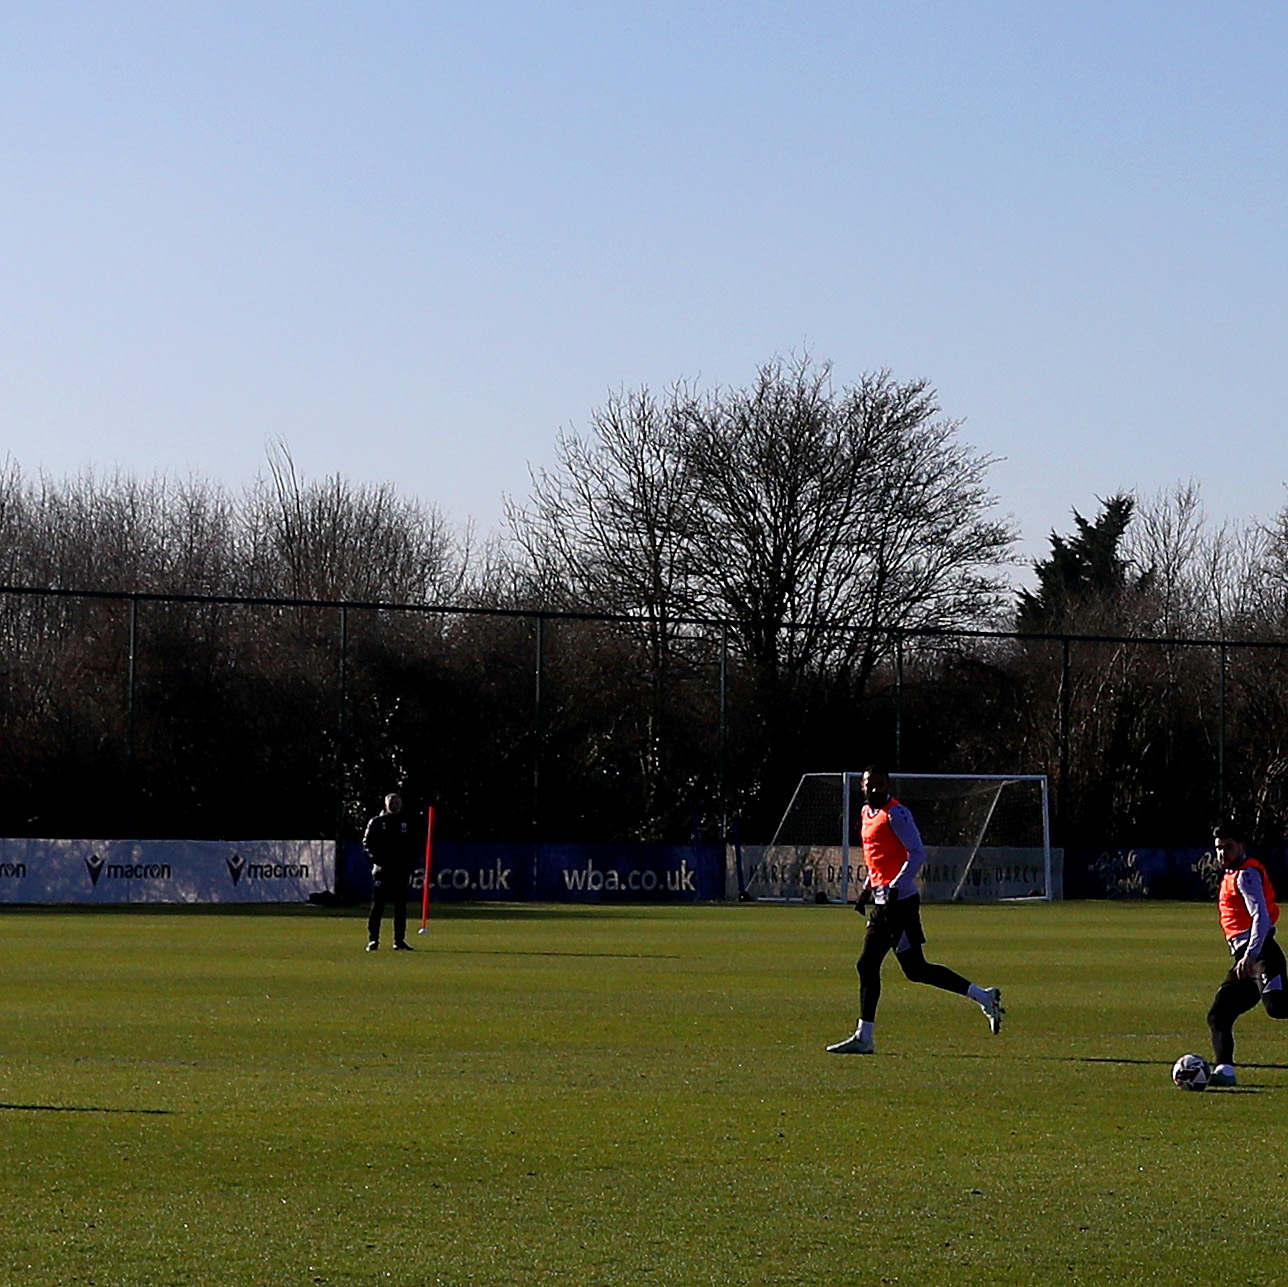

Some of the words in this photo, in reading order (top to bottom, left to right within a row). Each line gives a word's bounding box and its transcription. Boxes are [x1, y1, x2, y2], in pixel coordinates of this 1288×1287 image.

[107, 863, 171, 879] macron
[247, 863, 309, 879] macron
[562, 858, 696, 891] wba.co.uk
[995, 865, 1038, 883] DARCY
